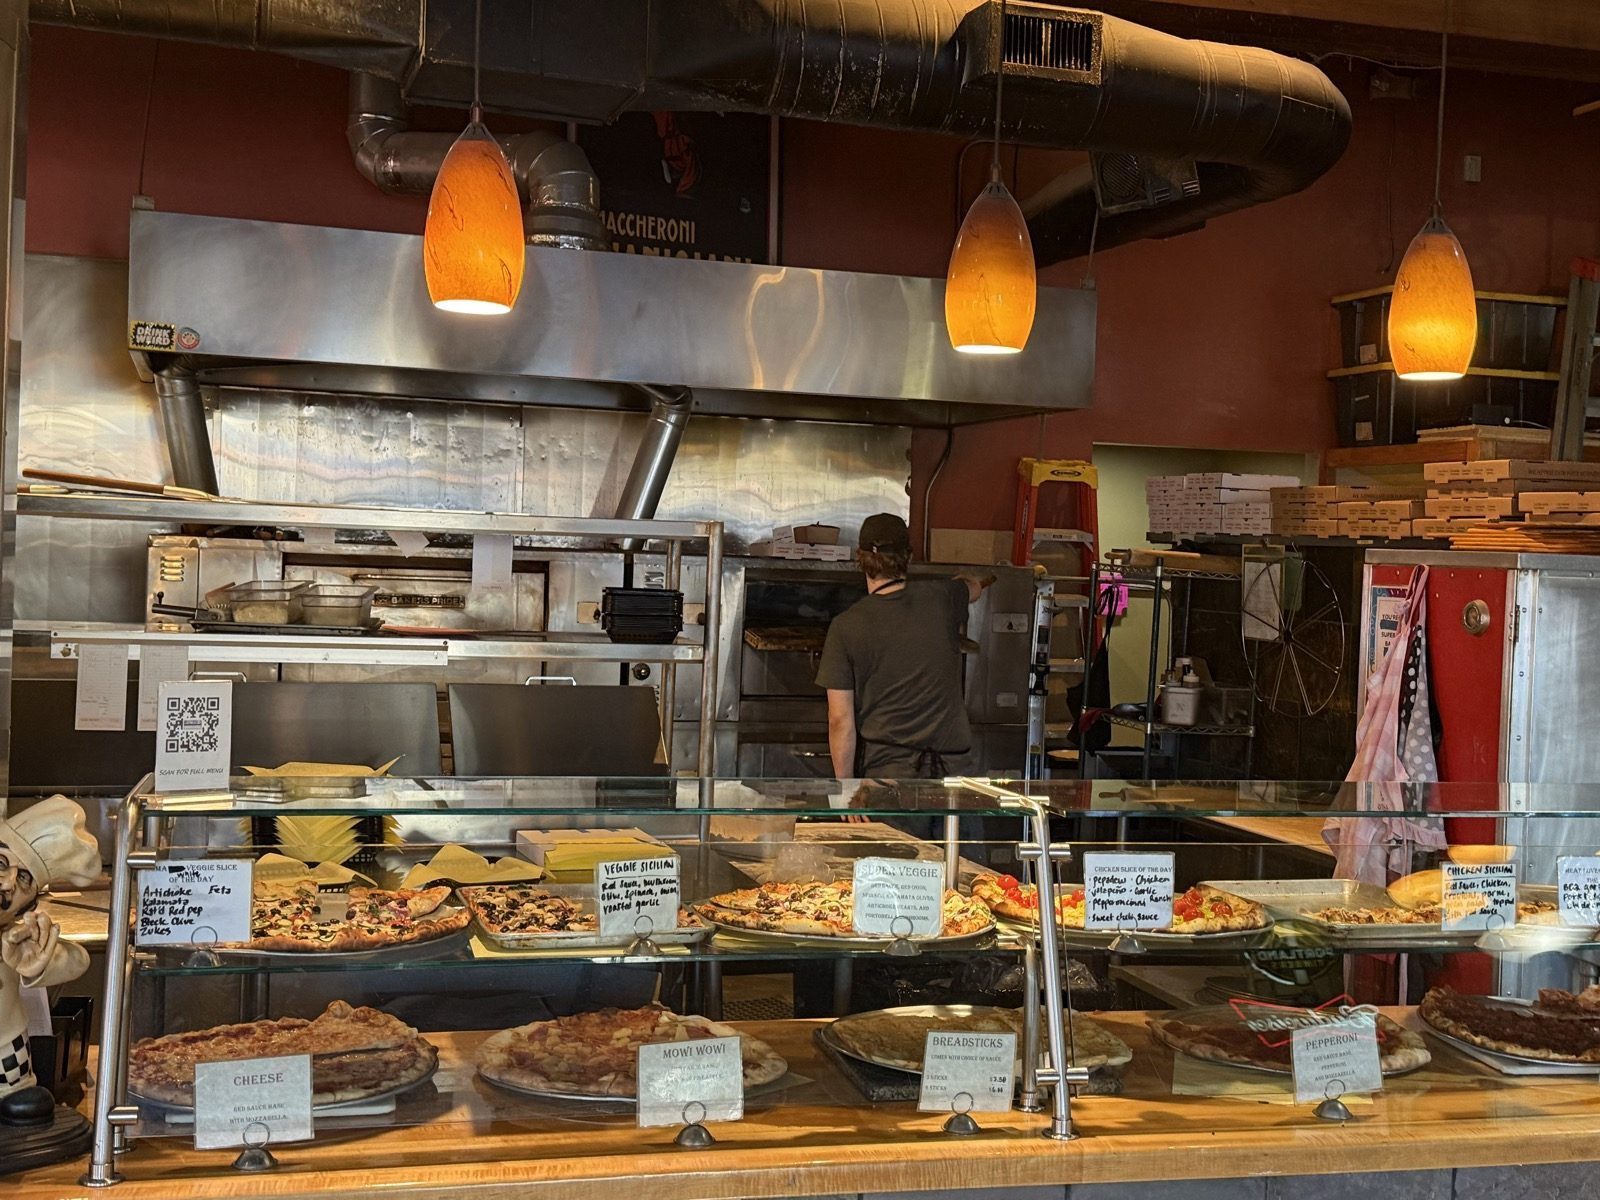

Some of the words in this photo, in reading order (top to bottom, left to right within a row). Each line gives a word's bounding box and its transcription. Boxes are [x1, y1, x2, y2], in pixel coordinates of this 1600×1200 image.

[137, 326, 170, 338] DRINK
[136, 334, 170, 345] WEIRD
[605, 861, 637, 875] VEGGIE
[641, 860, 674, 872] SICILIAN
[899, 866, 938, 878] VEGGIE
[1447, 865, 1482, 876] CHICKEN
[1484, 865, 1513, 874] SICILIAN
[1136, 874, 1170, 885] Chicken
[169, 905, 186, 915] Red
[187, 906, 203, 917] pep
[636, 898, 660, 914] garlic
[932, 1036, 1003, 1048] BREADSTICKS
[1306, 1032, 1358, 1051] PEPPERONI
[663, 1045, 693, 1059] MOWI
[696, 1043, 726, 1056] WOWI
[233, 1072, 284, 1086] CHEESE
